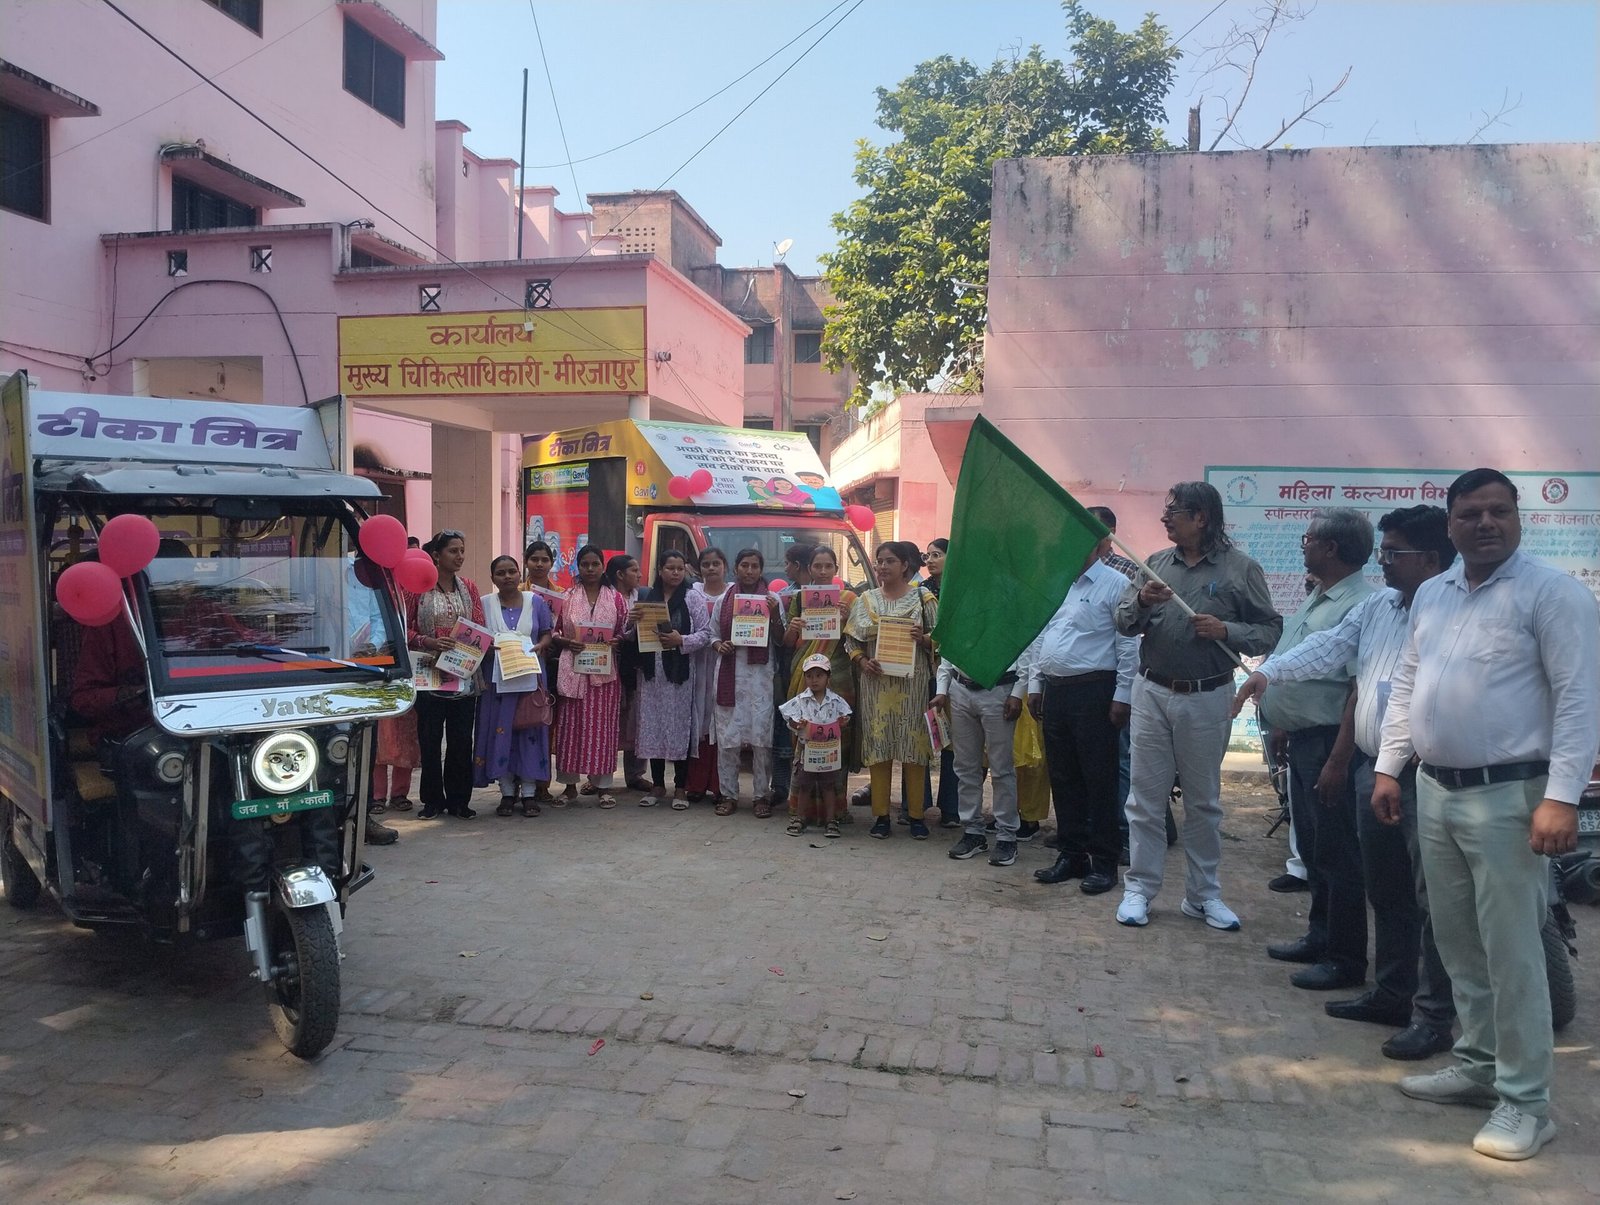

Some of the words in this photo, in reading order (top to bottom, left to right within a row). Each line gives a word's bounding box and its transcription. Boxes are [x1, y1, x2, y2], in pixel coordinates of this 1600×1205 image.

[427, 315, 537, 347] कार्यालय
[344, 364, 392, 391] मुख्य
[553, 353, 640, 390] मीरजापुर
[37, 406, 182, 444] टीका
[190, 416, 302, 452] मित्र
[549, 438, 579, 457] टीका
[580, 431, 612, 454] मित्र
[634, 486, 649, 497] Gavi
[1279, 480, 1335, 504] महिला
[1342, 486, 1417, 502] कल्याण
[1419, 480, 1449, 501] विभ
[239, 804, 258, 815] जय
[304, 792, 330, 806] काली
